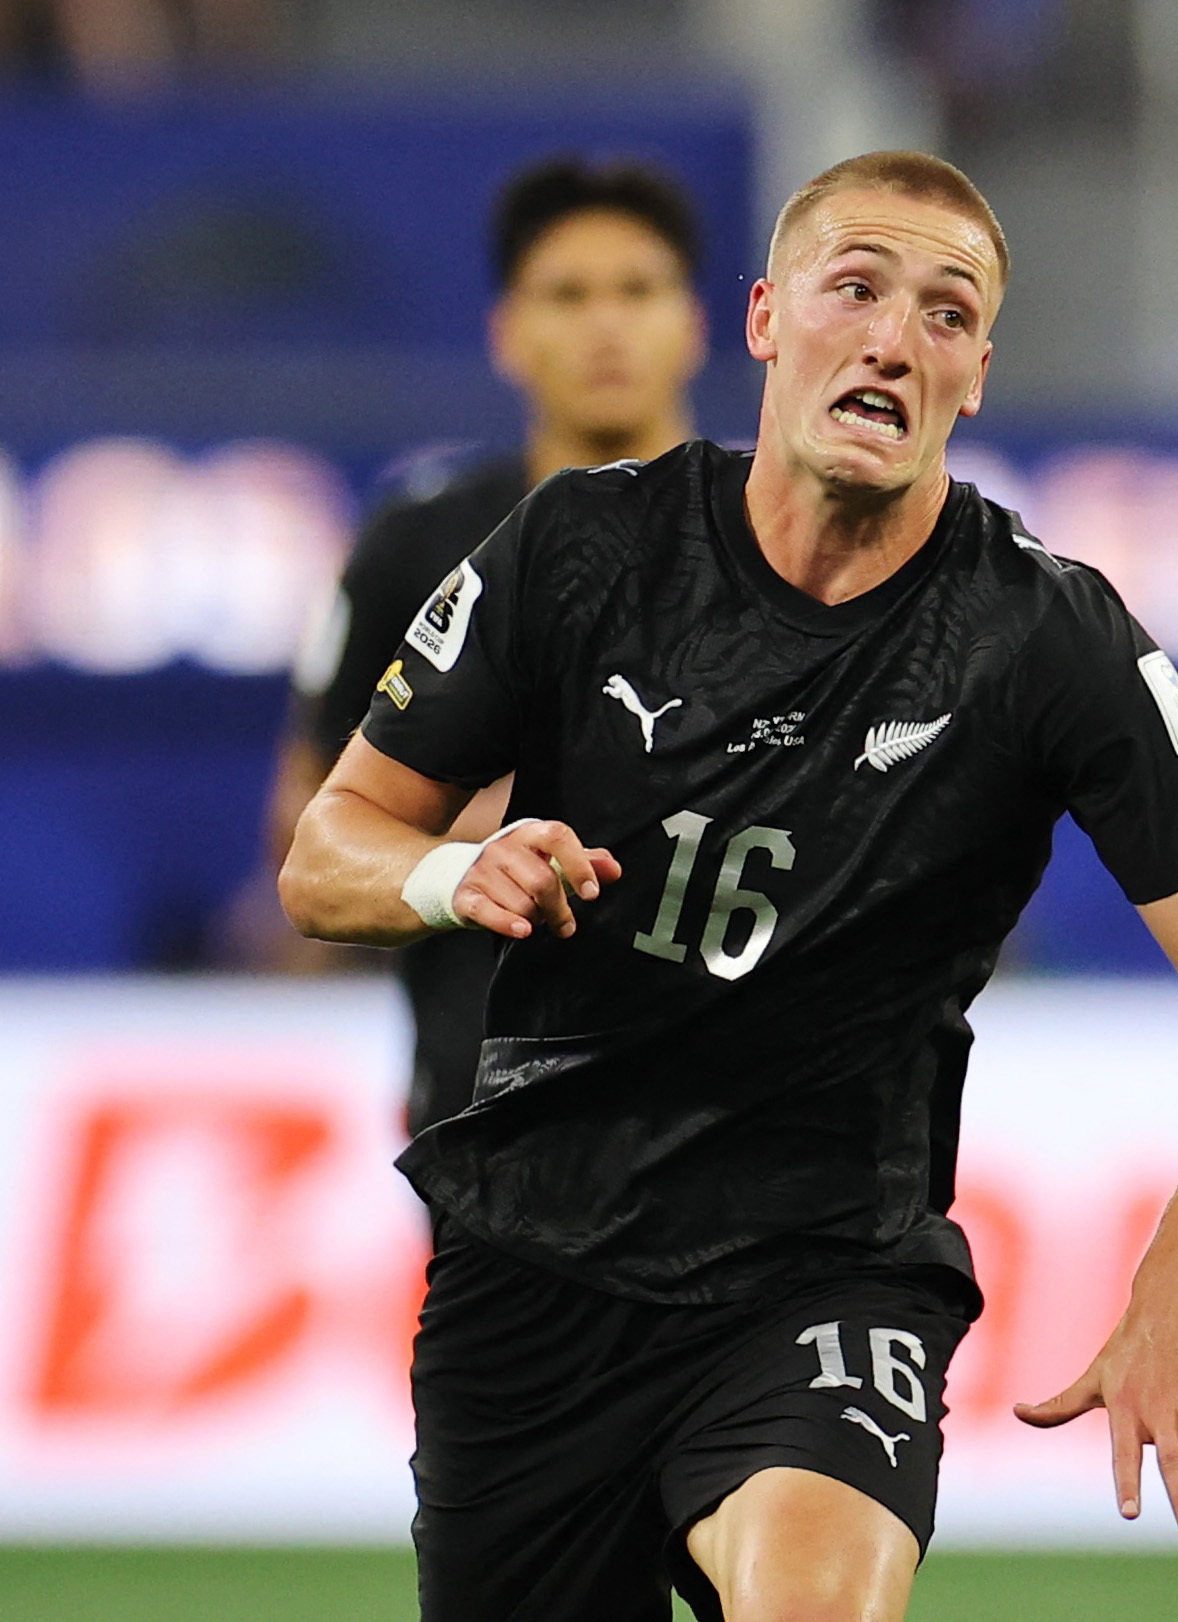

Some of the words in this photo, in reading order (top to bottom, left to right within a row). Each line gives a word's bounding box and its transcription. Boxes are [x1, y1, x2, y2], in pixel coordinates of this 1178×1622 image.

[413, 627, 440, 655] 2026
[727, 743, 746, 753] Los
[632, 810, 797, 982] 16
[795, 1320, 927, 1423] 16
